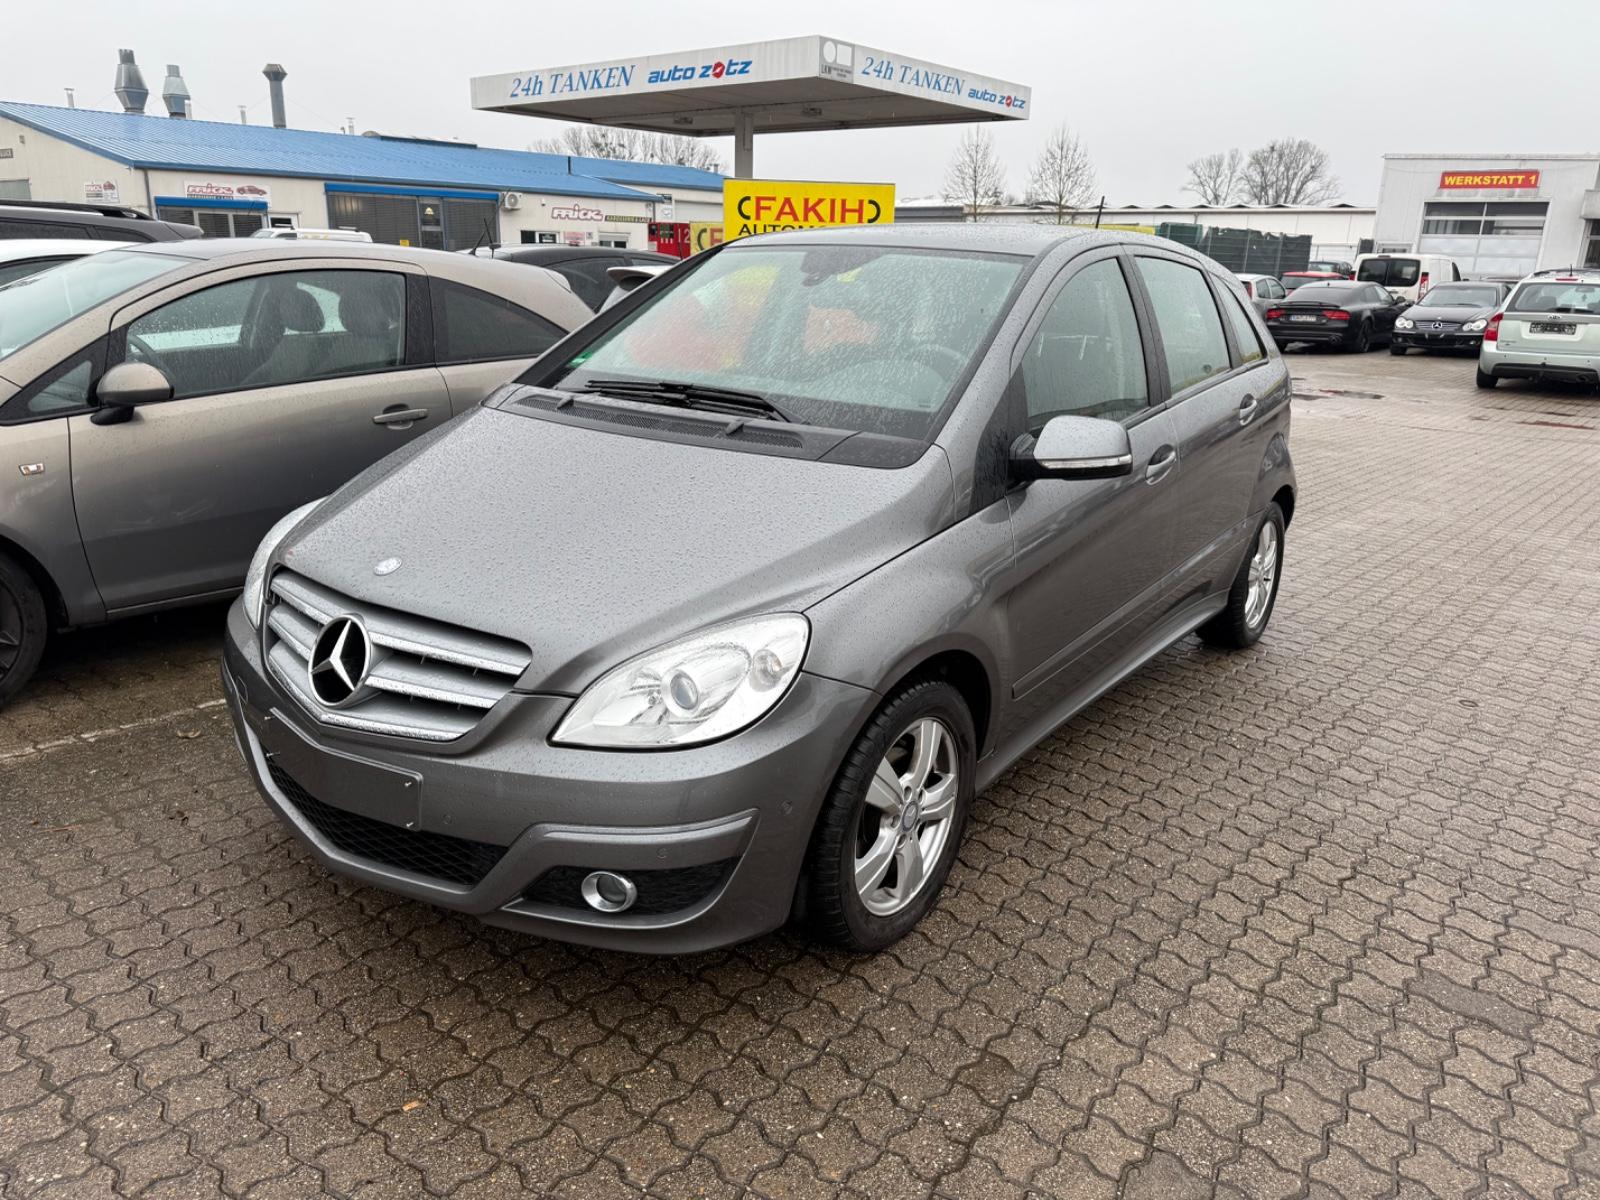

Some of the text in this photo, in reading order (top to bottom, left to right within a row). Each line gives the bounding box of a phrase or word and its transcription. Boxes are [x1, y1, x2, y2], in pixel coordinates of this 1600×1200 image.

[510, 64, 636, 97] 24h TANKEN
[648, 65, 696, 84] auto
[862, 56, 966, 96] 24h TANKEN
[968, 87, 997, 103] auto
[1444, 175, 1537, 186] WERKSTATT 1
